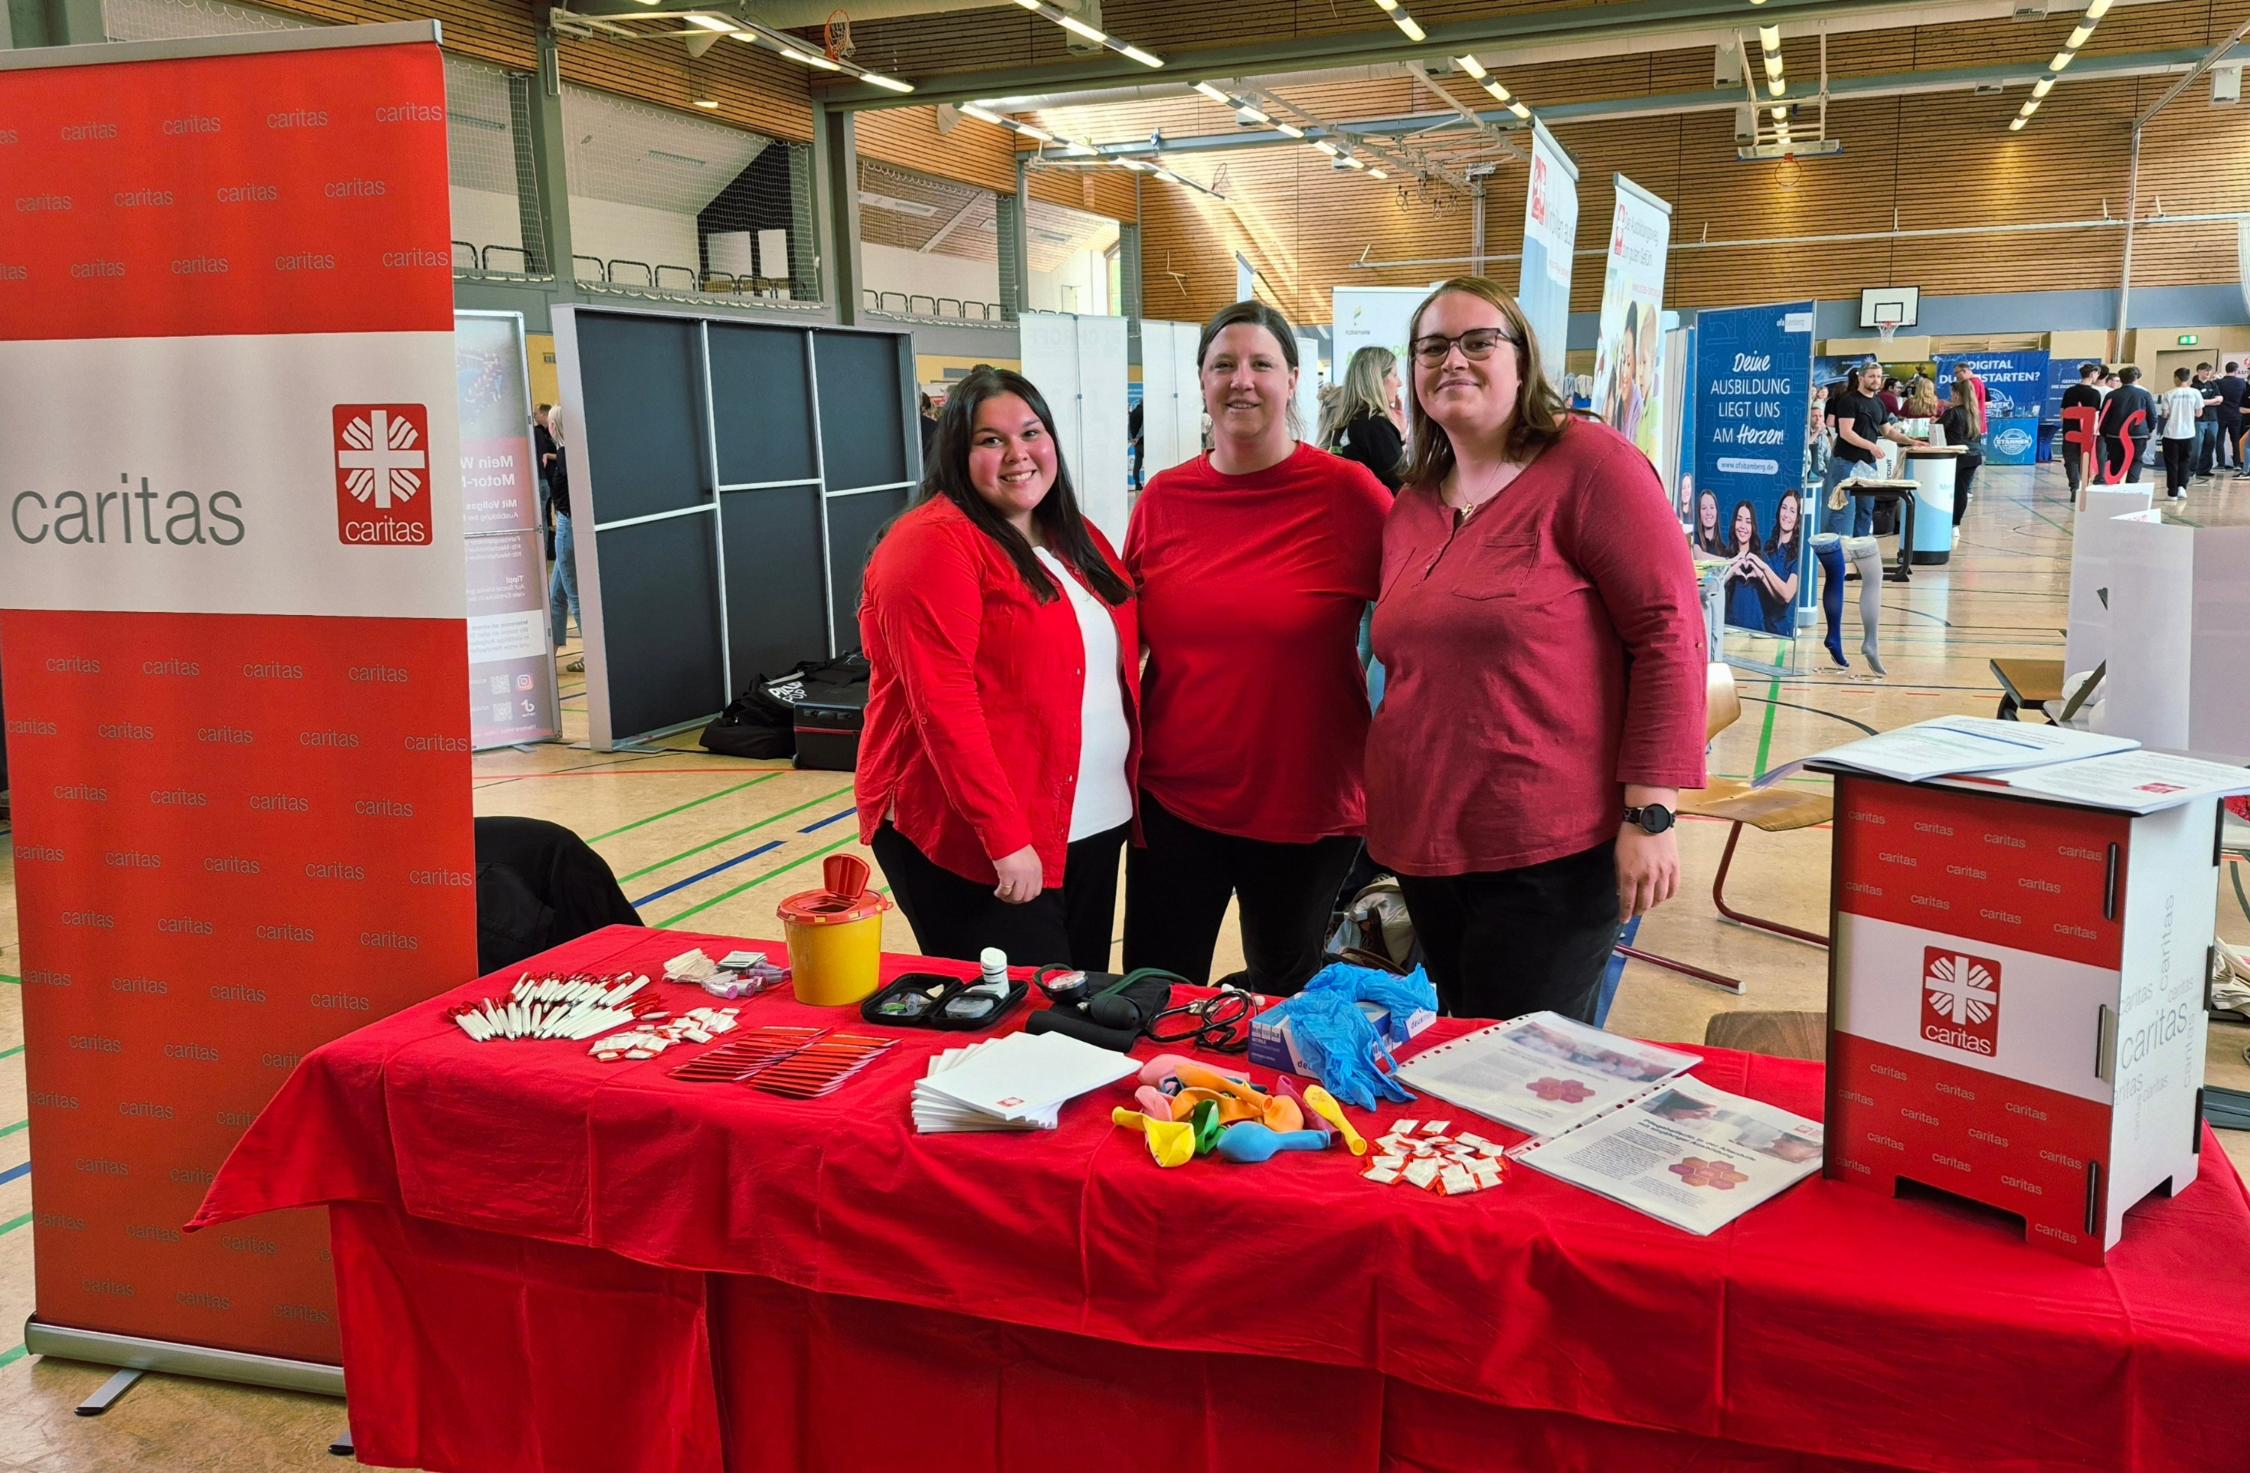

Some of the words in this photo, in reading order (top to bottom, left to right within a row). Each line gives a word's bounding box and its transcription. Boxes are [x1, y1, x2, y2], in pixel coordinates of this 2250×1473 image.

[61, 120, 118, 143] caritas
[162, 114, 221, 136] caritas
[266, 108, 329, 129] caritas
[375, 102, 443, 122] caritas
[16, 193, 73, 213] caritas
[114, 188, 174, 208] caritas
[217, 183, 278, 202] caritas
[324, 178, 386, 198] caritas
[70, 259, 126, 278] caritas
[171, 255, 229, 276] caritas
[275, 250, 336, 271] caritas
[382, 249, 449, 268] caritas
[1732, 350, 1770, 372] Deine
[1968, 360, 2013, 370] DIGITAL
[1710, 378, 1790, 395] AUSBILDUNG
[1718, 402, 1751, 417] LIEGT
[1754, 402, 1780, 418] UNS
[1713, 428, 1733, 443] AM
[1737, 424, 1784, 445] Herzen!
[11, 472, 246, 545] caritas
[345, 517, 425, 542] caritas
[46, 656, 101, 674] caritas
[143, 659, 201, 677] caritas
[243, 661, 304, 681] caritas
[348, 664, 409, 683] caritas
[98, 722, 154, 741] caritas
[198, 726, 254, 744] caritas
[300, 730, 360, 749] caritas
[404, 734, 468, 753] caritas
[54, 784, 108, 802] caritas
[150, 789, 207, 807] caritas
[249, 793, 309, 812] caritas
[355, 798, 414, 818] caritas
[1848, 809, 1886, 826] caritas
[1914, 820, 1954, 837] caritas
[1984, 831, 2026, 849] caritas
[2058, 845, 2102, 861] caritas
[105, 851, 161, 869] caritas
[204, 855, 261, 875] caritas
[305, 861, 366, 882] caritas
[409, 868, 473, 887] caritas
[1878, 850, 1917, 867] caritas
[1946, 863, 1987, 880] caritas
[2018, 876, 2061, 894] caritas
[1846, 880, 1883, 897] caritas
[1910, 893, 1950, 911] caritas
[1980, 907, 2022, 925] caritas
[2053, 921, 2097, 941] caritas
[62, 910, 114, 928] caritas
[157, 916, 214, 935] caritas
[256, 922, 315, 943] caritas
[360, 929, 419, 951] caritas
[2160, 894, 2175, 991] caritas
[112, 976, 168, 995] caritas
[210, 984, 266, 1004] caritas
[311, 991, 370, 1012] caritas
[68, 1034, 122, 1054] caritas
[165, 1041, 219, 1062] caritas
[262, 1050, 303, 1069] carit
[1926, 1025, 1992, 1055] caritas
[2121, 1002, 2188, 1070] caritas
[1870, 1062, 1908, 1081] caritas
[1935, 1081, 1975, 1101] caritas
[2005, 1100, 2048, 1121] caritas
[2113, 1073, 2143, 1106] aritas
[119, 1099, 174, 1120] caritas
[1838, 1088, 1874, 1107] caritas
[1901, 1106, 1940, 1127] caritas
[1968, 1126, 2009, 1148] caritas
[2039, 1148, 2082, 1170] caritas
[75, 1156, 129, 1177] caritas
[171, 1166, 215, 1186] carita
[1834, 1156, 1872, 1175] caritas
[1867, 1130, 1905, 1152] caritas
[1932, 1152, 1972, 1172] caritas
[2001, 1173, 2043, 1196] caritas
[125, 1223, 182, 1244] caritas
[221, 1233, 278, 1256] caritas
[2035, 1221, 2077, 1244] caritas
